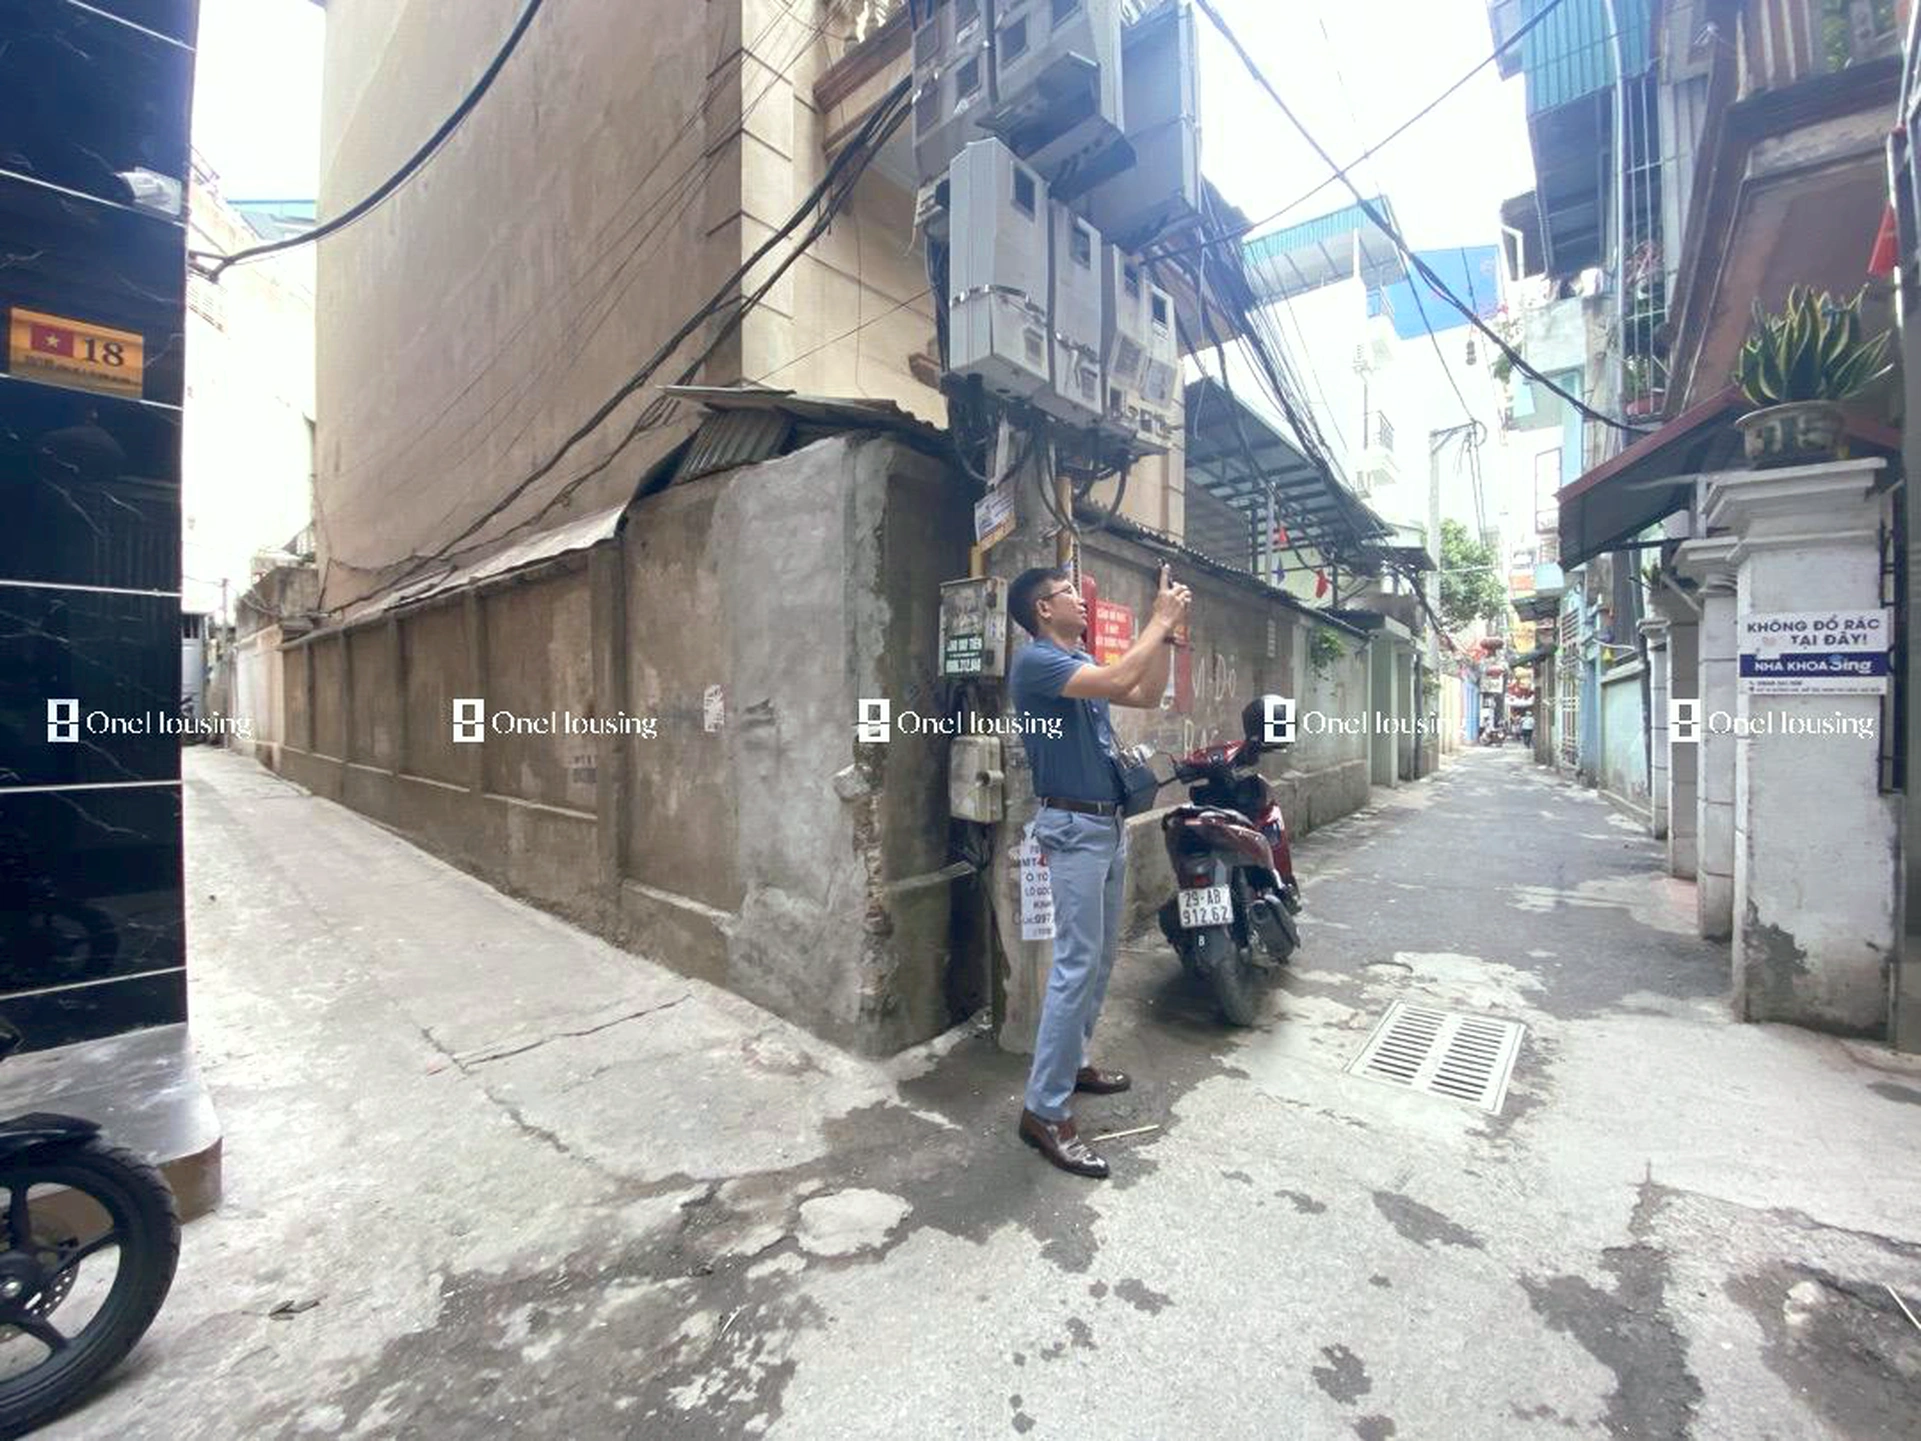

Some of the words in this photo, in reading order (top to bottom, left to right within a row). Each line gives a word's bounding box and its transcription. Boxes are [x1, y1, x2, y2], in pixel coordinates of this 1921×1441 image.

[84, 336, 125, 367] 18
[1747, 618, 1808, 633] KHÔNG
[1813, 614, 1839, 631] ĐỔ
[1844, 615, 1880, 630] RÁC
[1790, 634, 1818, 650] TẠI
[1787, 661, 1828, 671] KHOA
